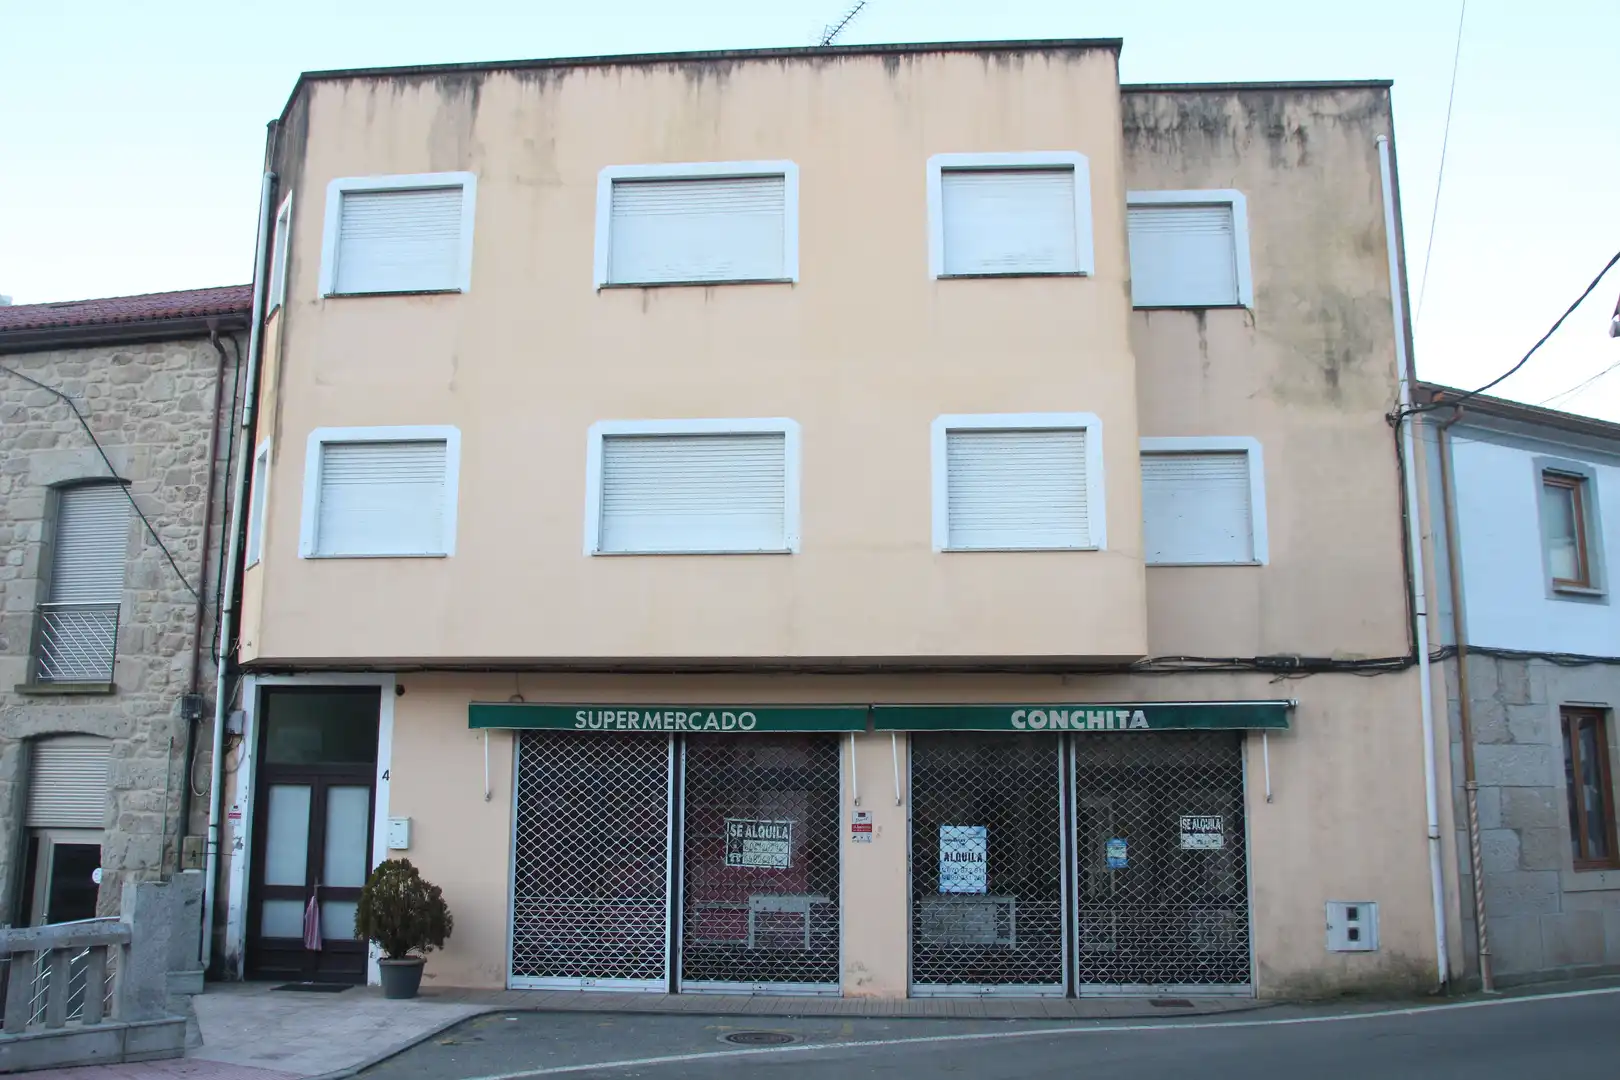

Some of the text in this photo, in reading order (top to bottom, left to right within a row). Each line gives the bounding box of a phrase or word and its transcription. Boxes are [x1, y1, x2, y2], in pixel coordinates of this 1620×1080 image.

[574, 710, 757, 730] SUPERMERCADO
[1010, 709, 1150, 729] CONCHITA
[381, 769, 390, 781] 4
[730, 823, 789, 839] SE ALQUILA
[1182, 818, 1191, 830] SE
[943, 851, 983, 863] ALQUILA
